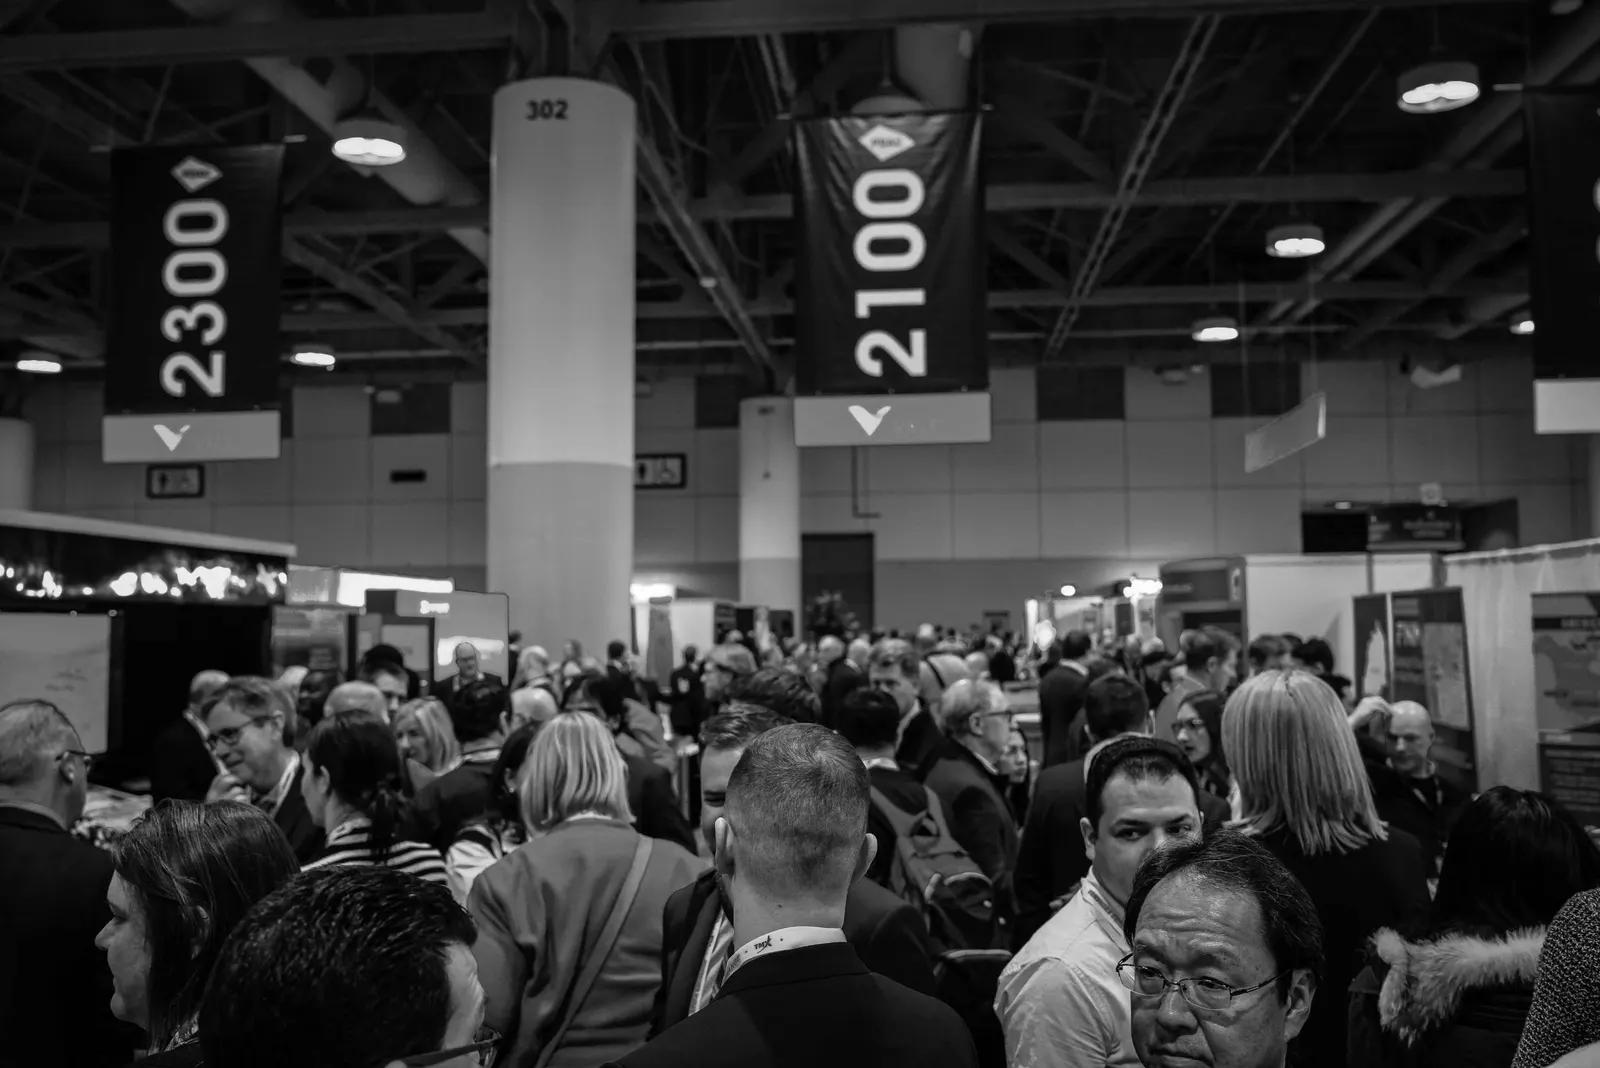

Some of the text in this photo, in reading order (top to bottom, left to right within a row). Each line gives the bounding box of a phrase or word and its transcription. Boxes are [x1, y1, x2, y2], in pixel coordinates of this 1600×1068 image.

[525, 98, 569, 121] 302
[161, 200, 228, 397] 2300
[852, 169, 927, 378] 2100
[754, 935, 773, 954] TMX
